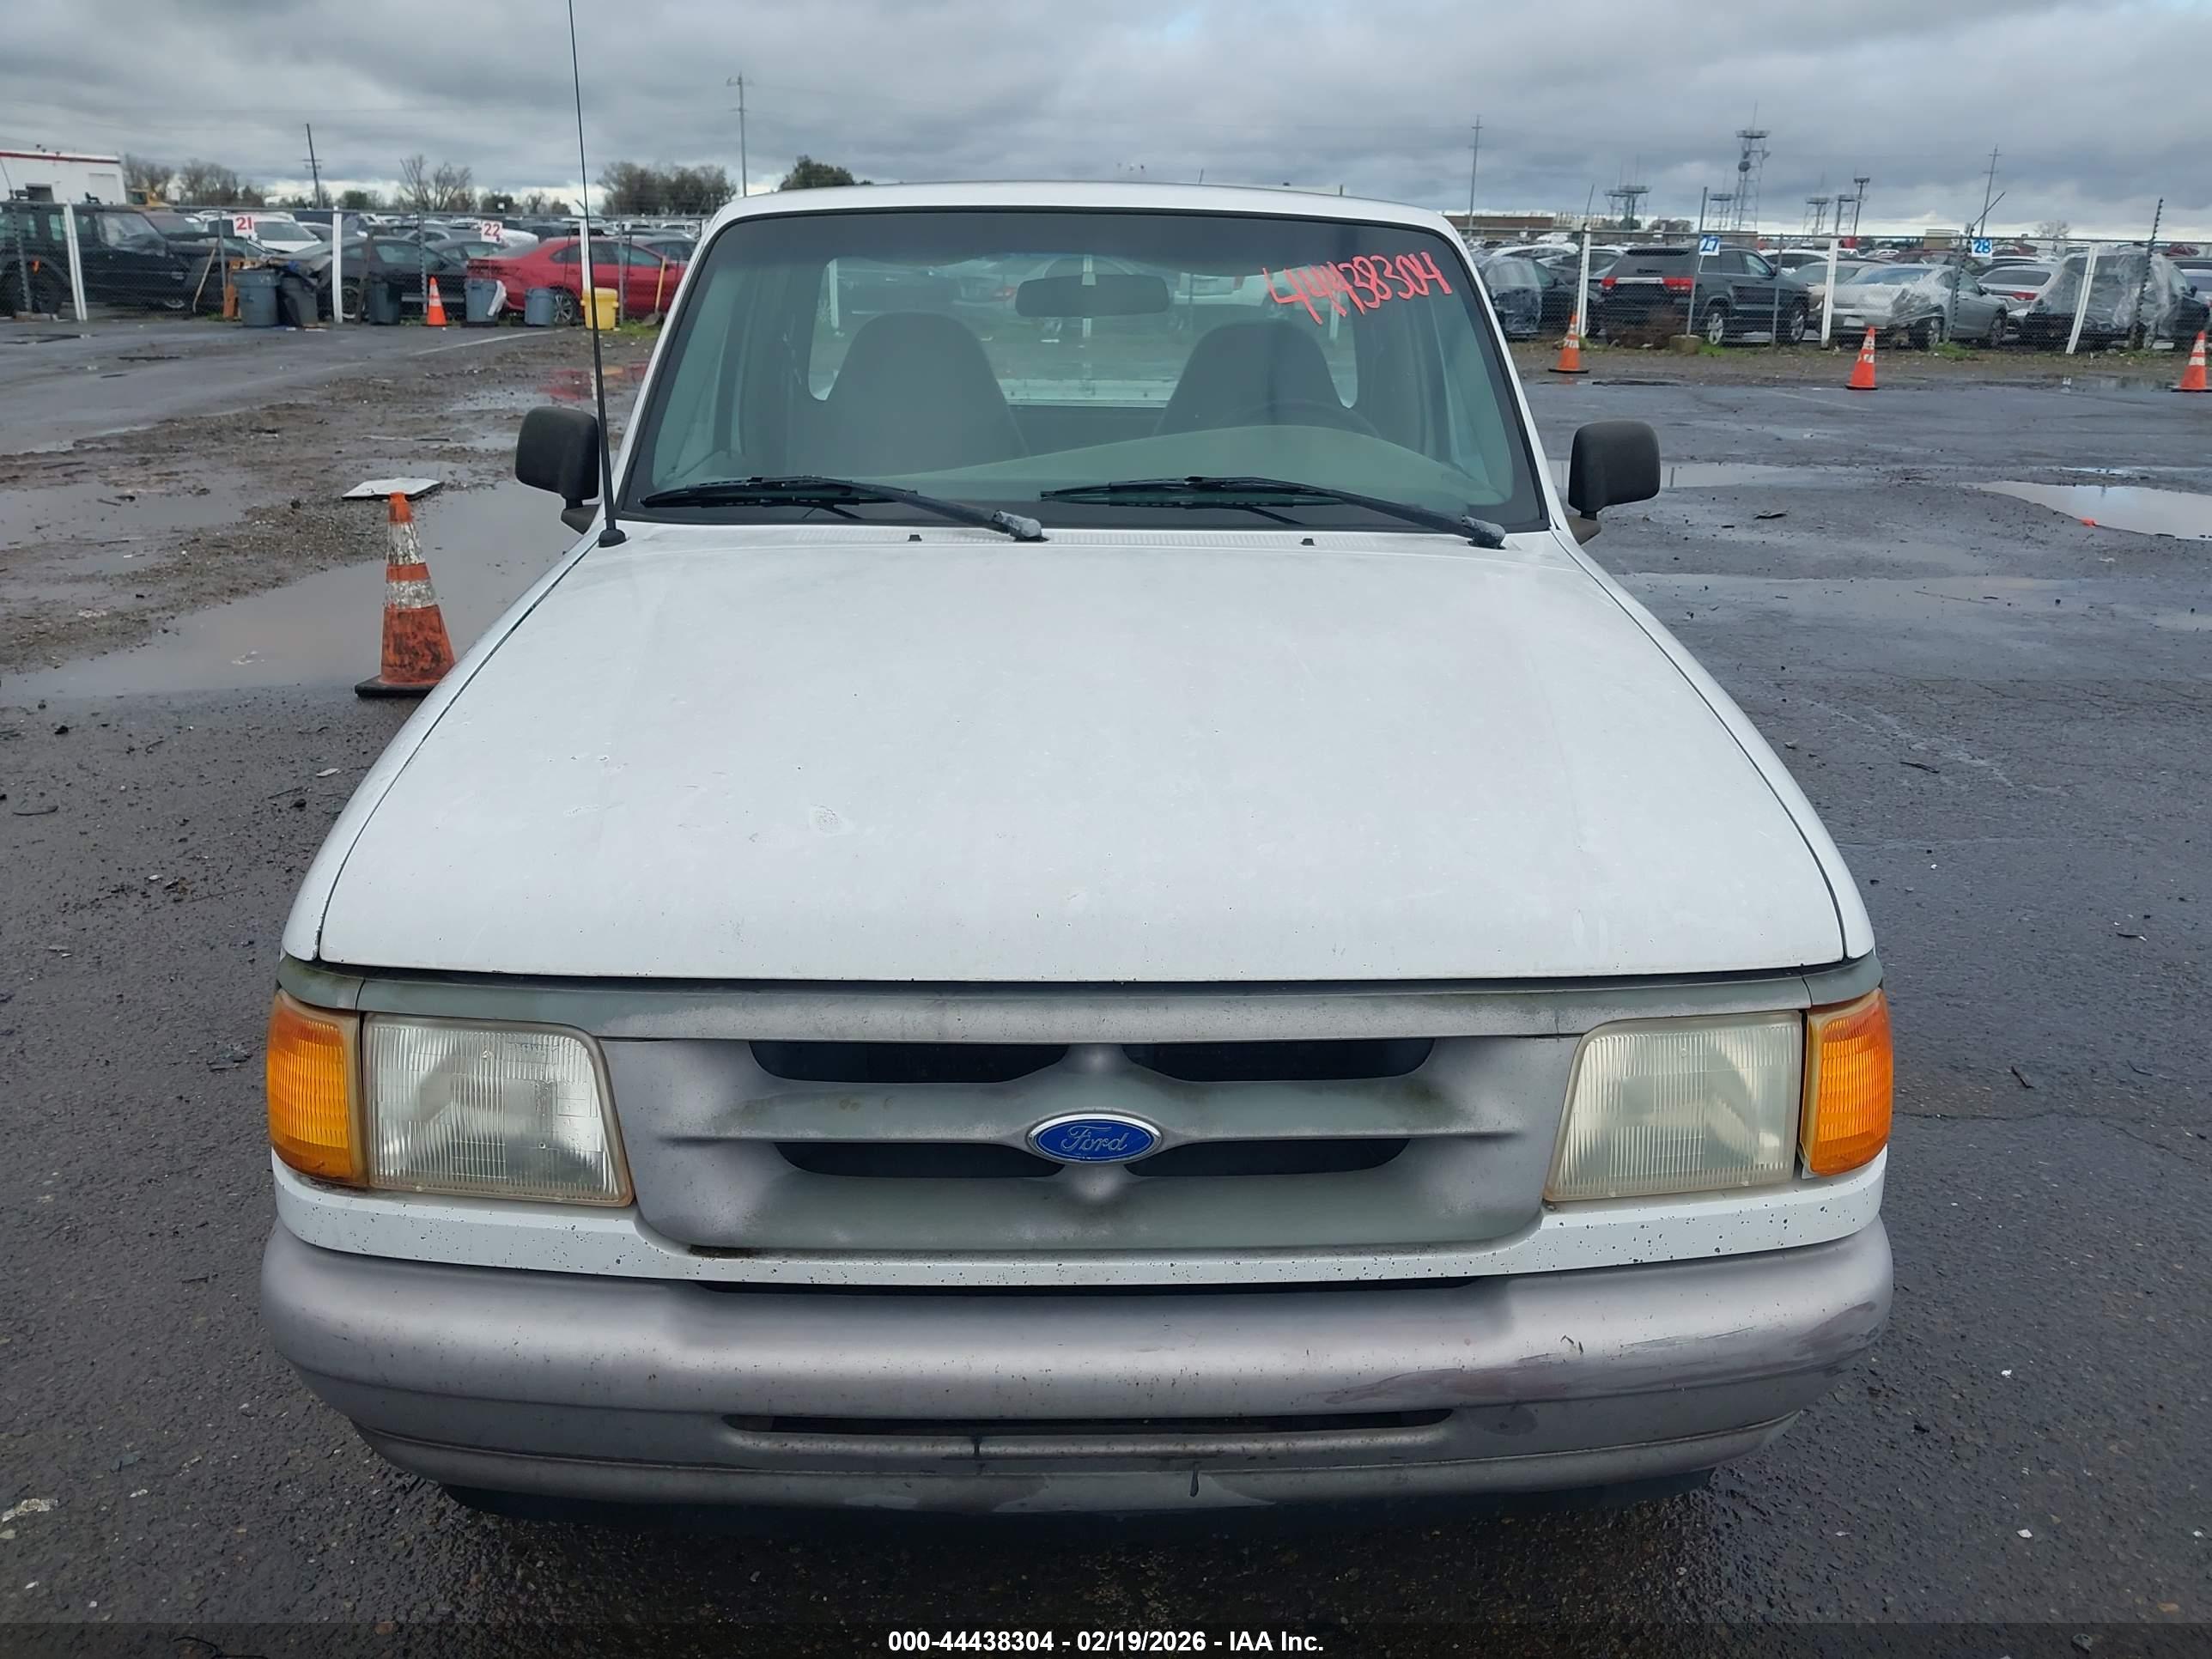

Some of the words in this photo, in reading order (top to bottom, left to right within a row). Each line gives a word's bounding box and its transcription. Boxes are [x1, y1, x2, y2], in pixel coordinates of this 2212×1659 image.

[235, 216, 252, 230] 21
[483, 222, 501, 236] 22
[1700, 236, 1719, 252] 27
[1973, 239, 1991, 253] 28
[1261, 252, 1453, 325] 44438304
[1060, 1125, 1127, 1152] Ford
